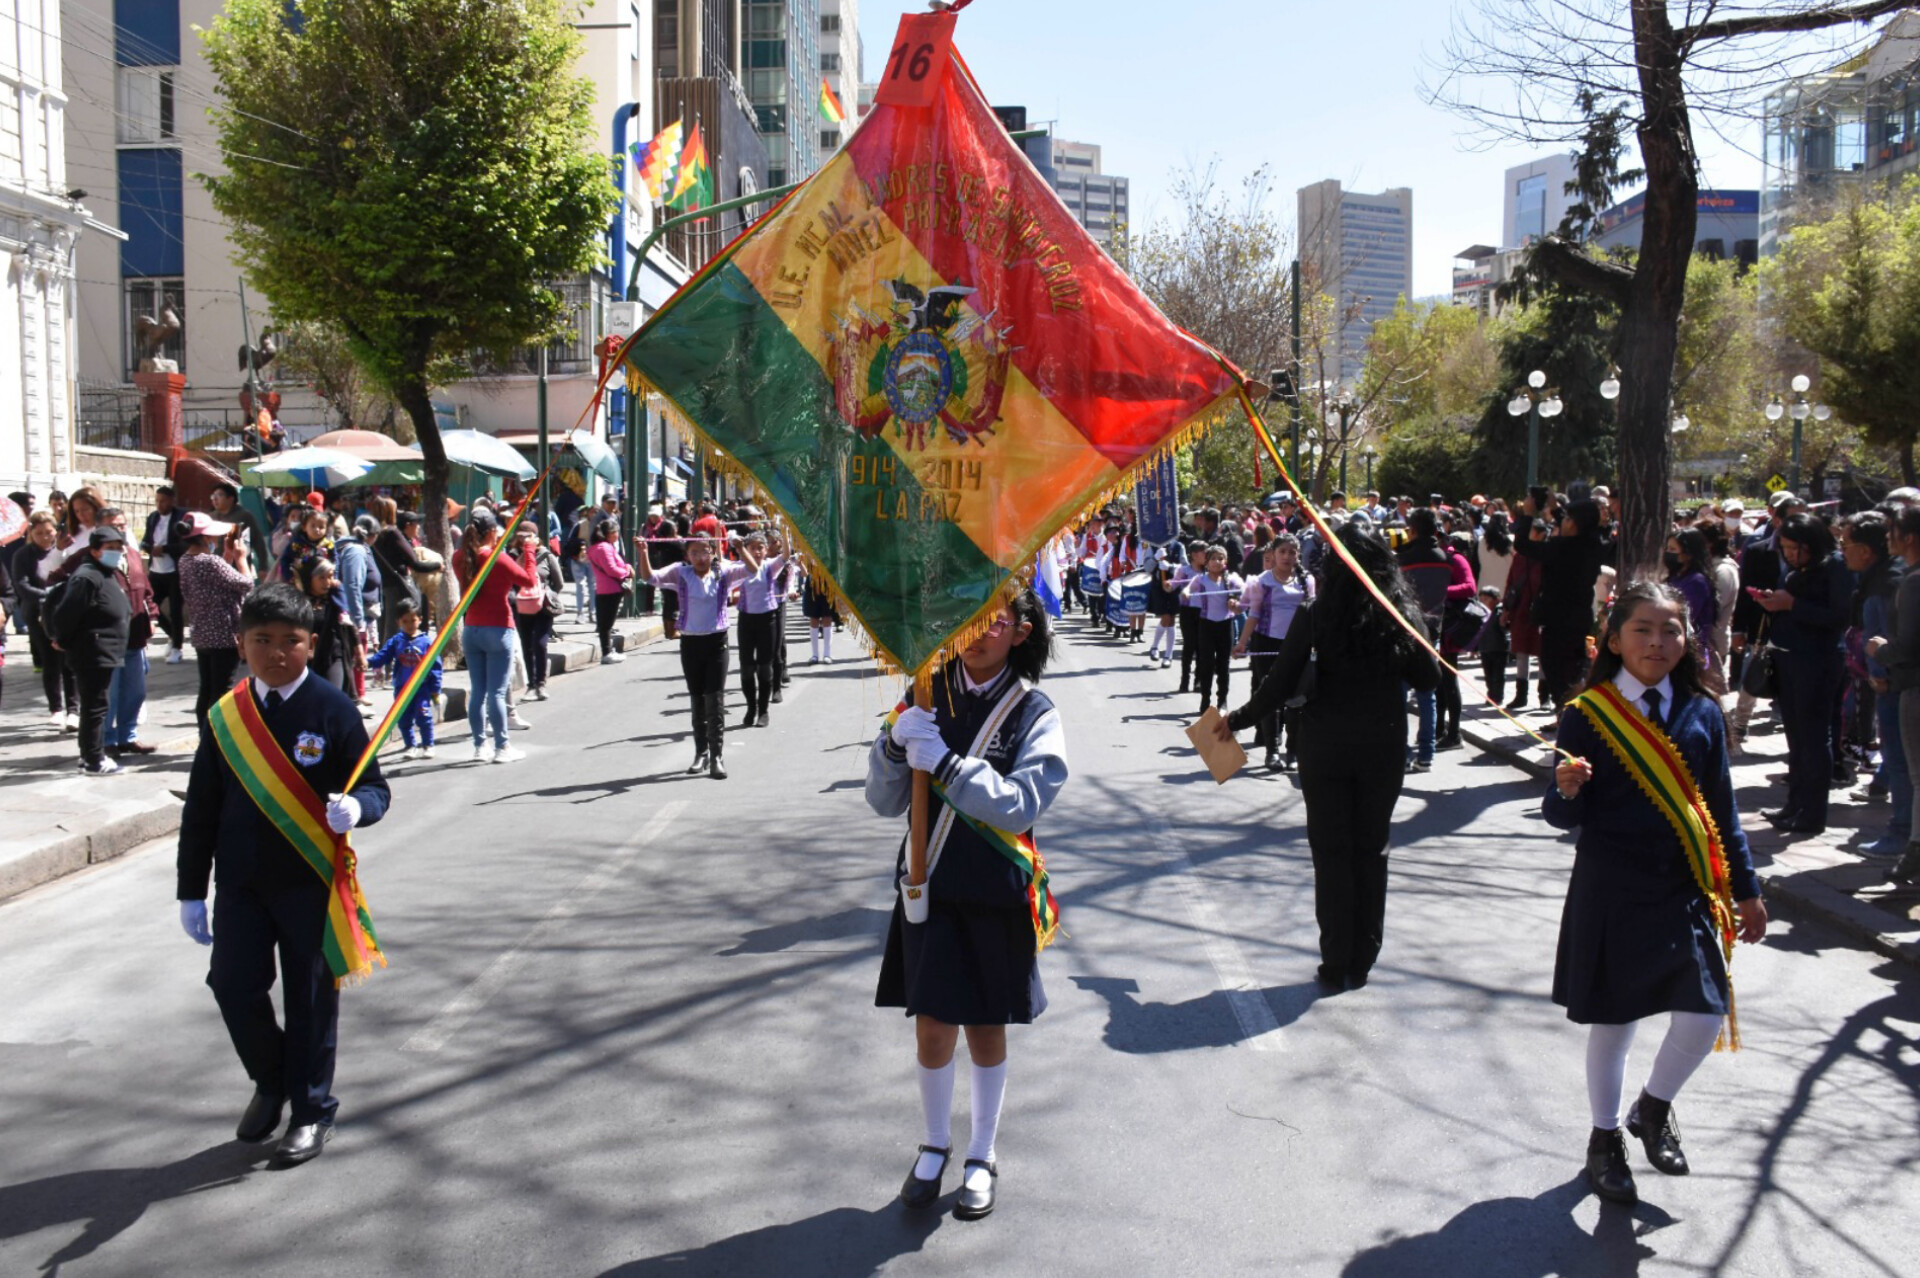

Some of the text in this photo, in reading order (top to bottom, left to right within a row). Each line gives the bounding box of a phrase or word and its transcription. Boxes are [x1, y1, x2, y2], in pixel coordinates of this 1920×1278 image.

[891, 42, 935, 82] 16
[826, 198, 1021, 276] NIVEL PRIMARIO
[862, 162, 948, 211] ANDRES
[957, 172, 984, 208] DE
[988, 186, 1048, 255] SANTA
[1035, 244, 1083, 314] CRUZ
[921, 457, 982, 491] 2014
[876, 489, 963, 523] LA PAZ
